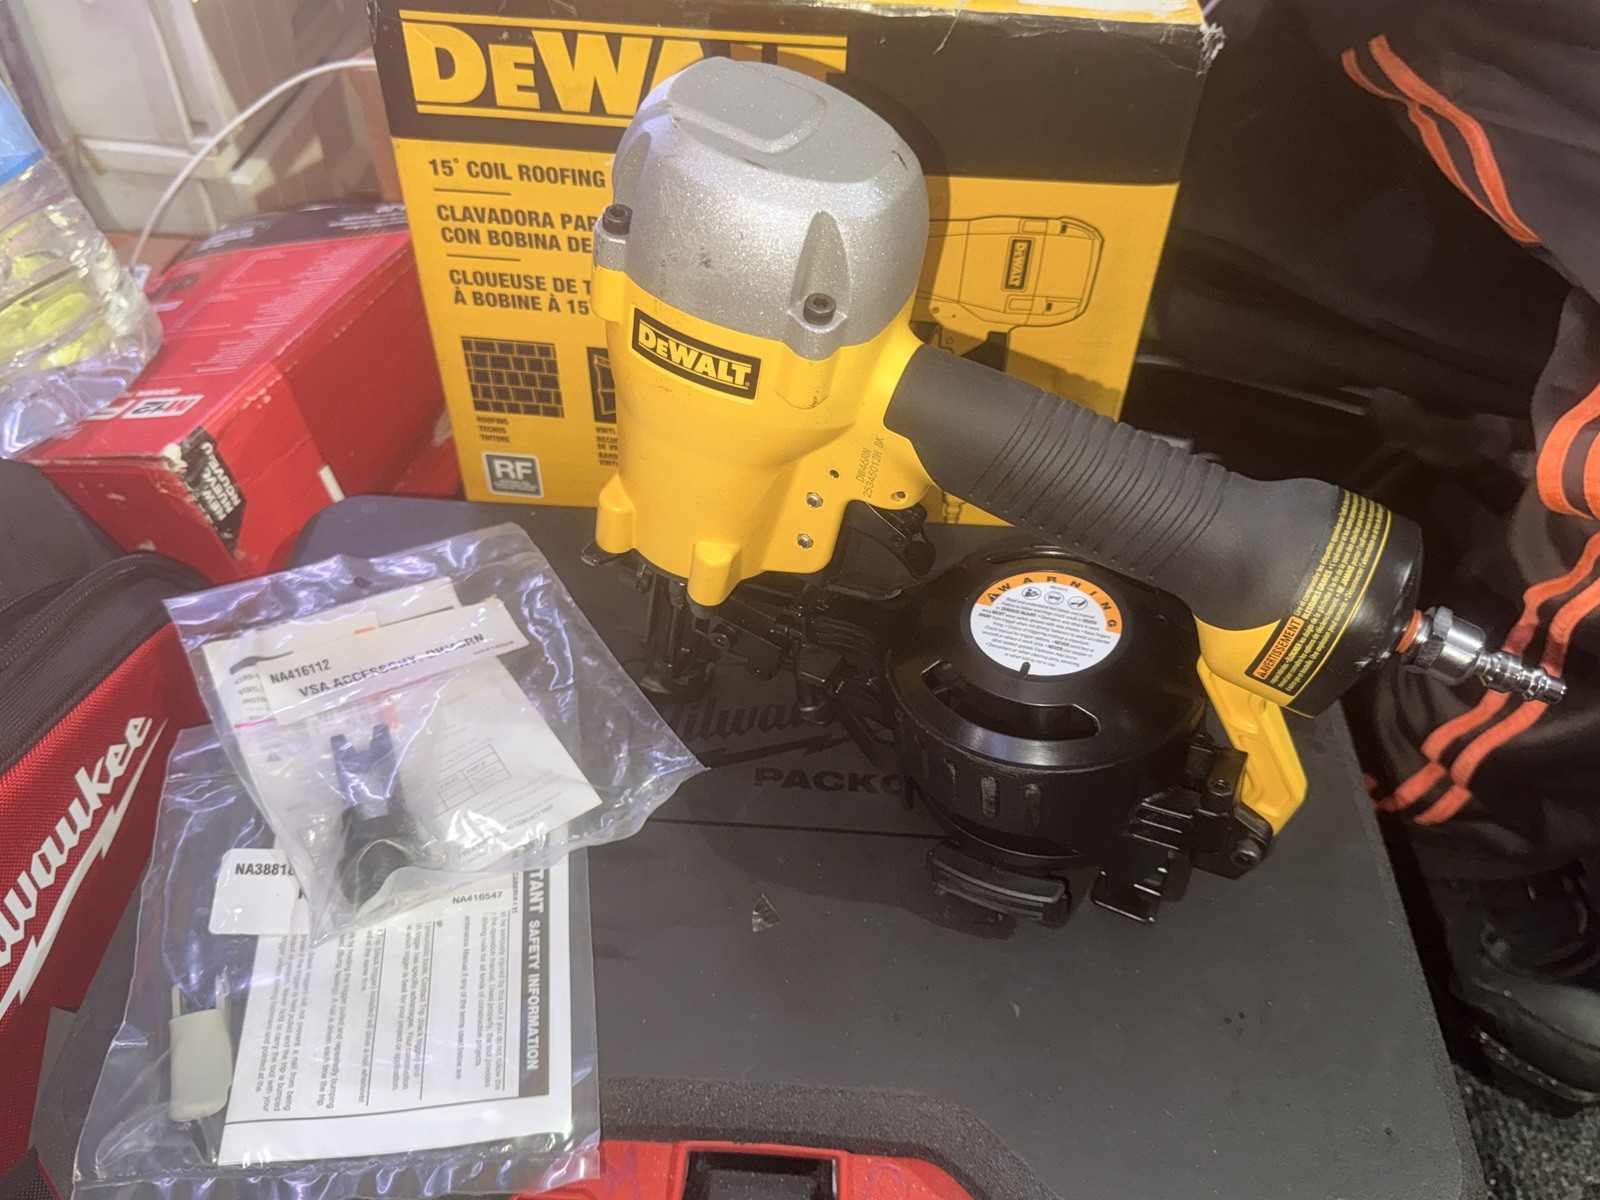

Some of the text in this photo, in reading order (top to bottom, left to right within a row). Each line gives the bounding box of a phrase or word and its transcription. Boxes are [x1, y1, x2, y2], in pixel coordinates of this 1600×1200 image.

[467, 161, 513, 181] COIL
[518, 163, 606, 188] ROOFING
[436, 204, 555, 229] CLAVADORA
[440, 226, 592, 253] CON BOBINA DE
[1007, 241, 1025, 289] DEWALT
[449, 268, 547, 291] CLOUEUSE
[553, 277, 578, 294] DE
[453, 285, 468, 306] À
[473, 291, 543, 311] BOBINE
[548, 293, 561, 313] À
[638, 322, 752, 386] DEWALT
[493, 459, 532, 480] RF
[855, 447, 872, 483] DW46RN
[999, 576, 1117, 628] WARNING
[1260, 618, 1302, 676] AVERTISSEMENT
[269, 658, 332, 684] NA416112
[299, 682, 330, 697] VSA
[753, 766, 904, 796] PACKO
[0, 716, 152, 967] waukee
[452, 890, 503, 905] NA416547
[527, 919, 541, 970] SAFETY
[526, 973, 540, 1071] INFORMATION
